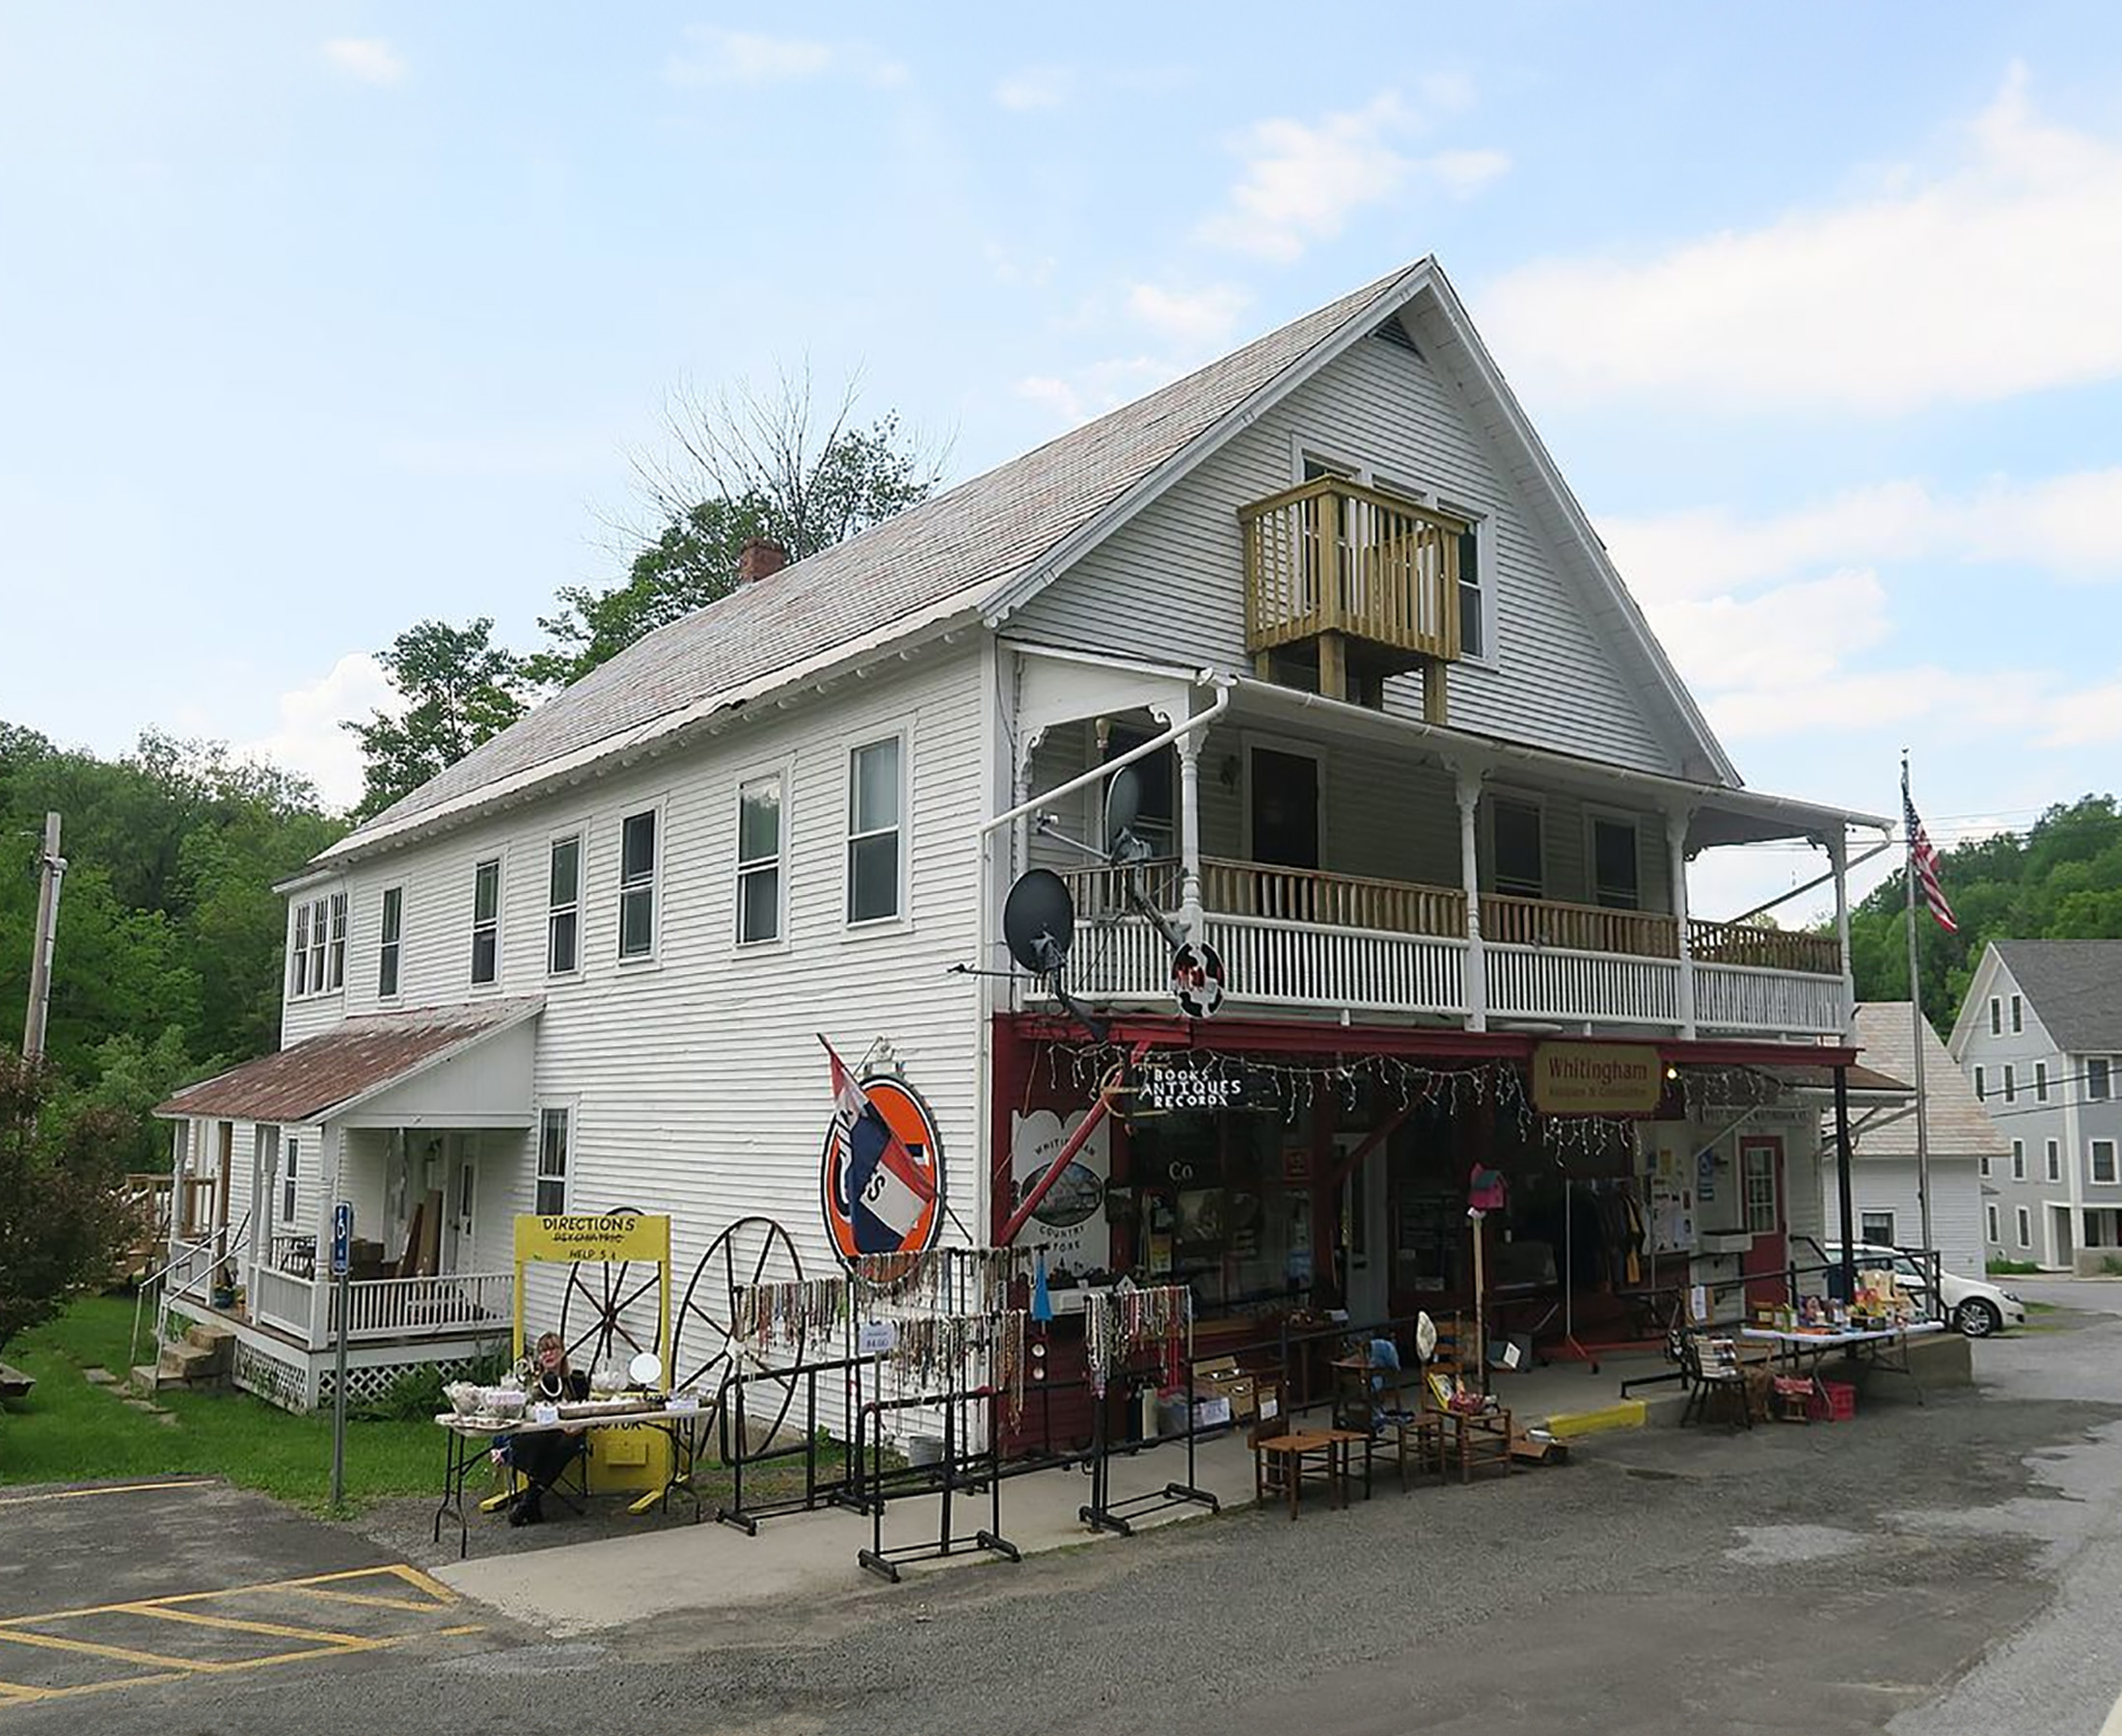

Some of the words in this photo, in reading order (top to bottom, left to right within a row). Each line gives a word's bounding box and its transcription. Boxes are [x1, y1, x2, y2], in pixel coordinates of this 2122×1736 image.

[1154, 1069, 1210, 1082] BOOKS
[1548, 1056, 1648, 1085] Whitingham
[1141, 1079, 1242, 1097] ANTIQUES
[542, 1217, 636, 1232] DIRECTIONS
